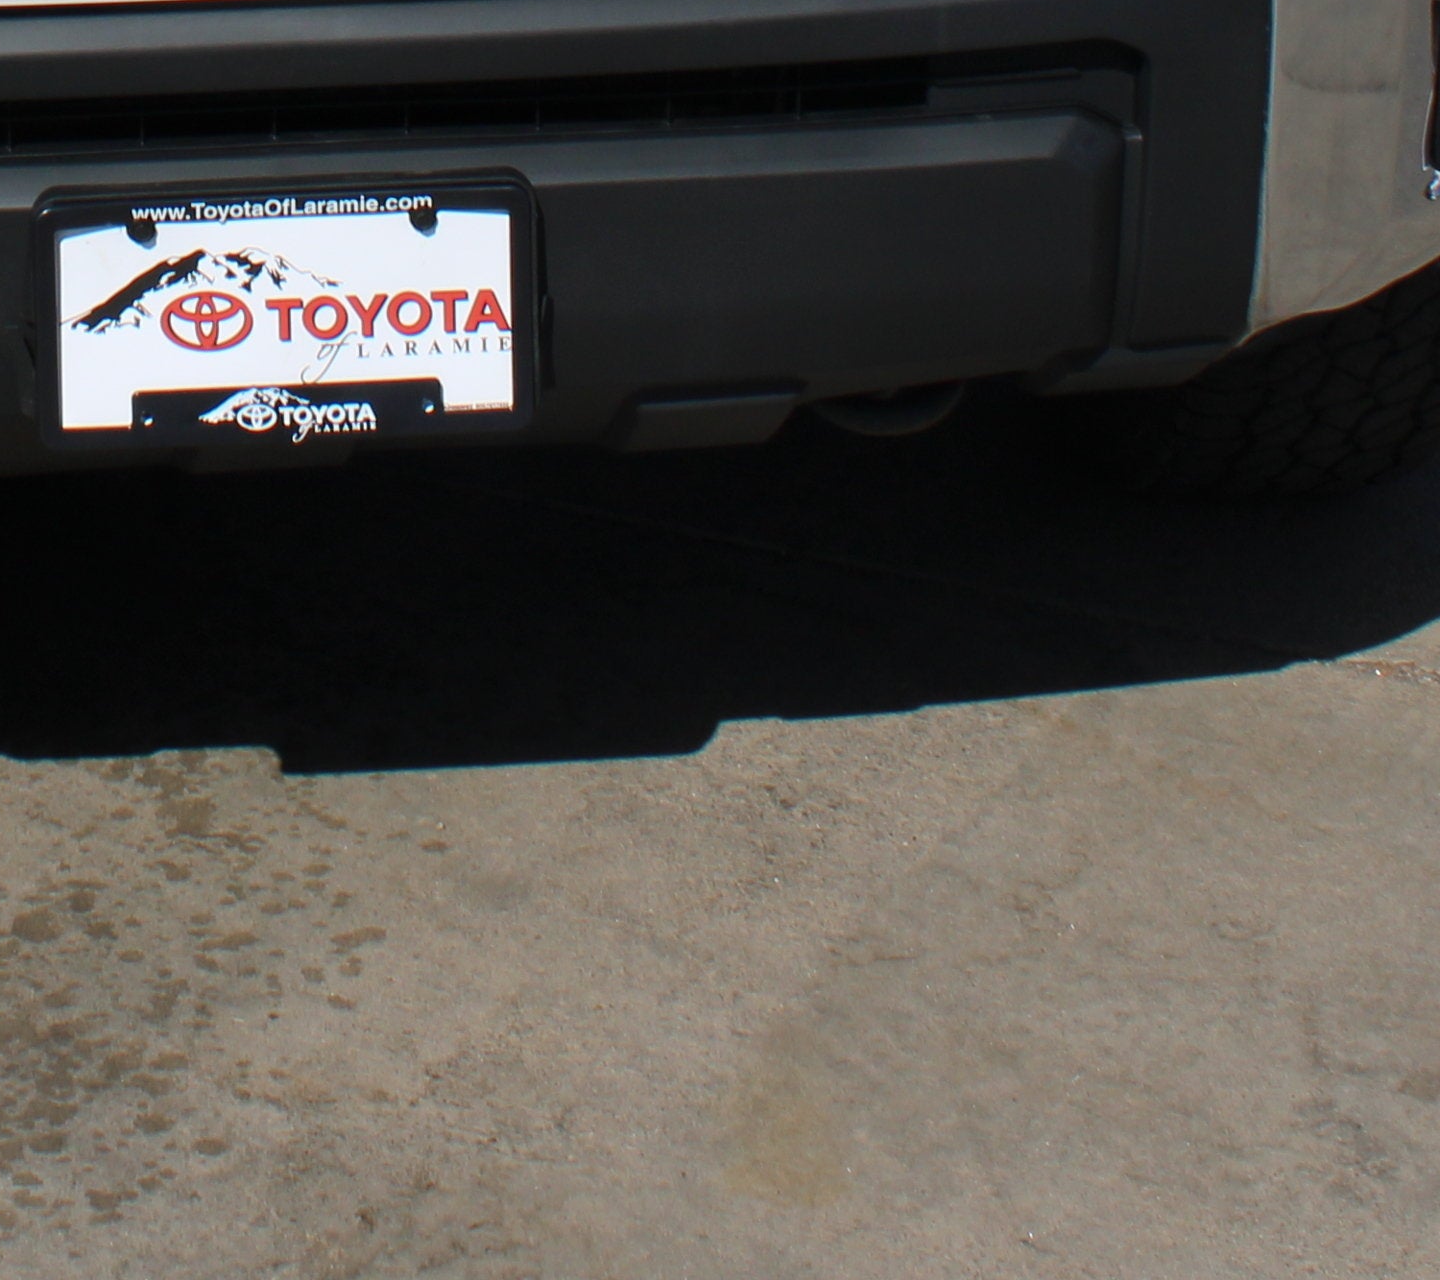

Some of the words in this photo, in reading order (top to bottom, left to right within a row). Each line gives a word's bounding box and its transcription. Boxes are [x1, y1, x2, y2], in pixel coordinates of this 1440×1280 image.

[132, 194, 433, 222] www.ToyotaOfLaramie.com
[266, 289, 512, 342] TOYOTA
[301, 331, 358, 384] of
[358, 336, 512, 359] LARAMIE
[278, 403, 377, 427] TOYOTA
[314, 420, 377, 434] LARAMIE
